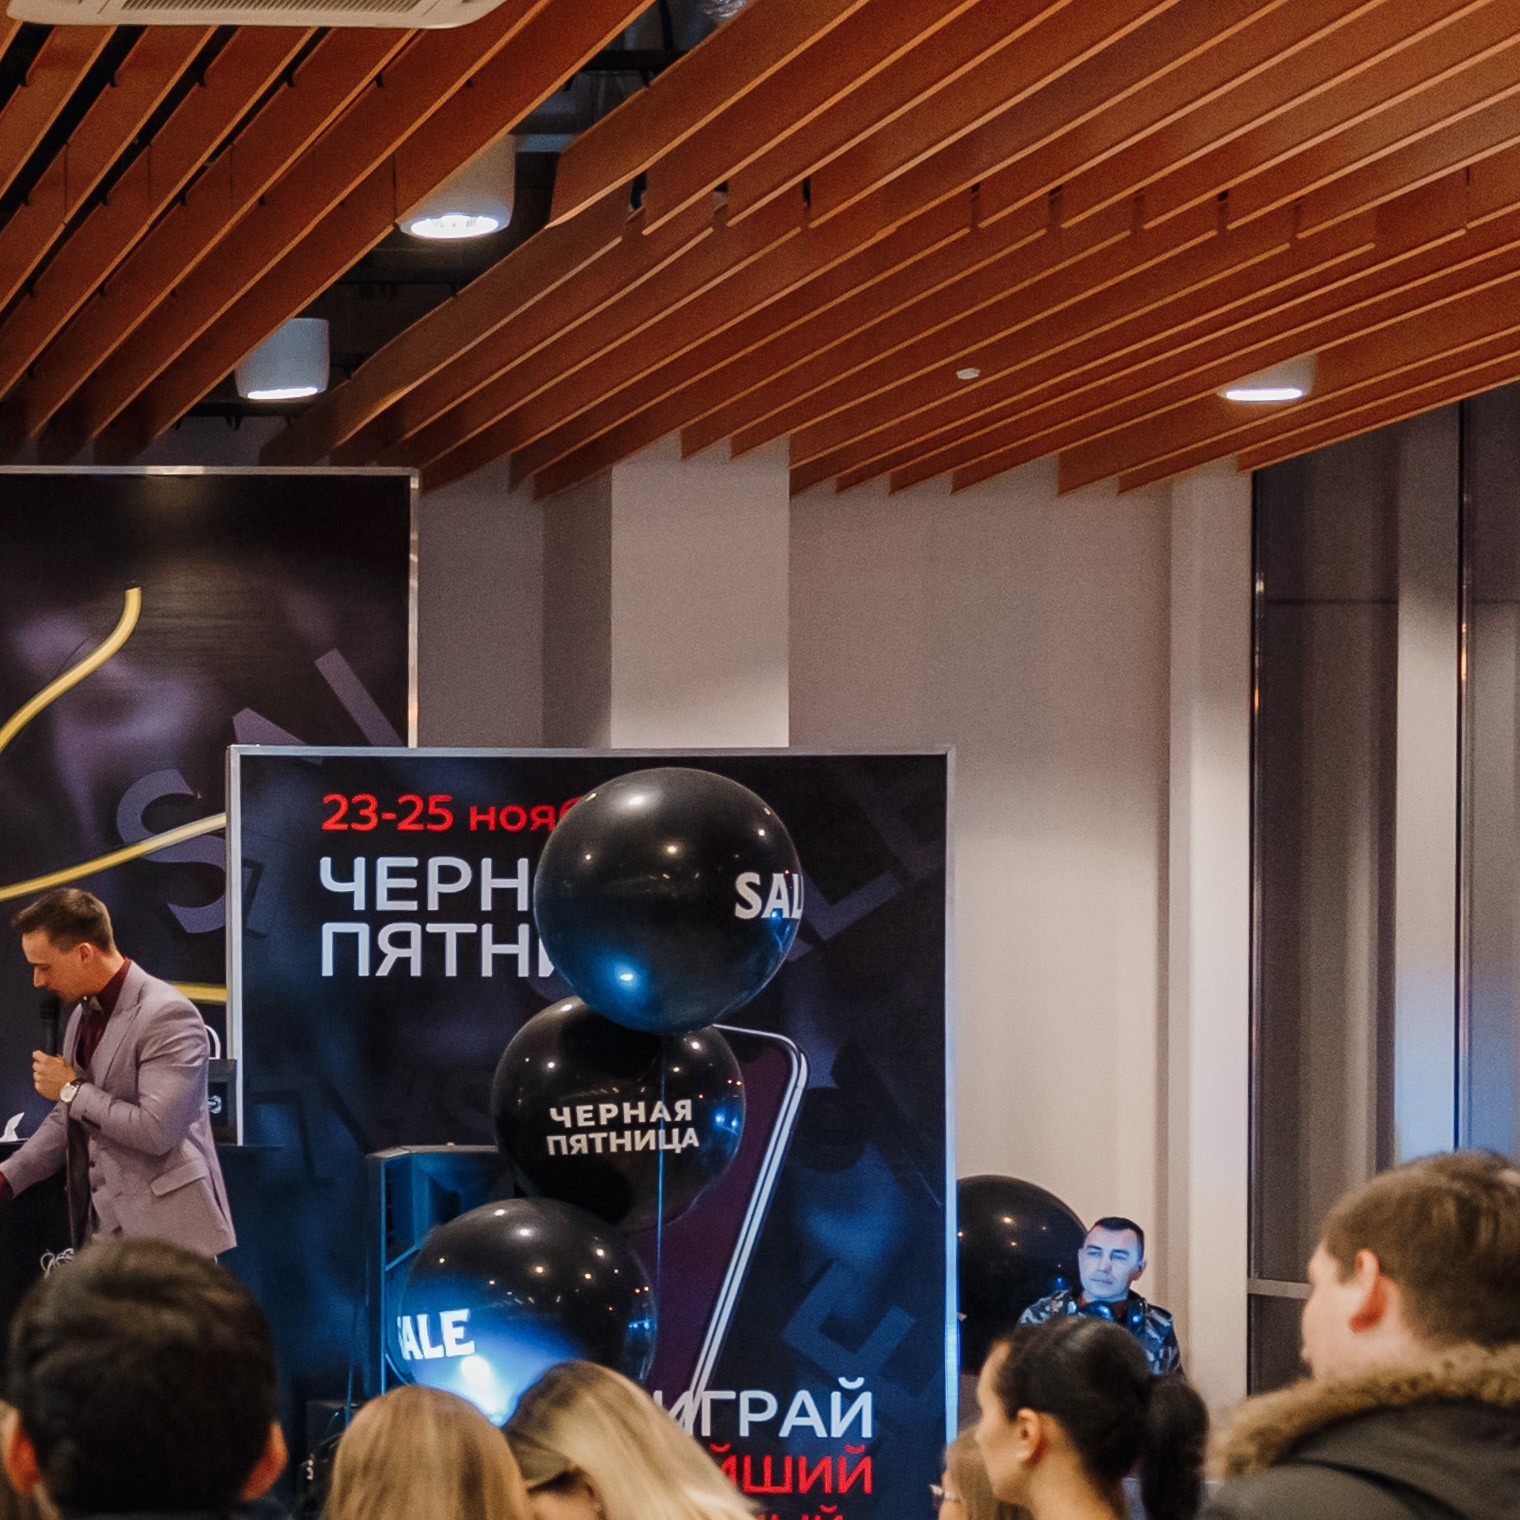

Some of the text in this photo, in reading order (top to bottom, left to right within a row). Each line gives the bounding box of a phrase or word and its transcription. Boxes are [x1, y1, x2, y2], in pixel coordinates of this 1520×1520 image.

[321, 793, 582, 831] 23-25 ноя
[319, 856, 529, 912] ЧЕРН
[734, 872, 802, 920] SAL
[321, 922, 555, 978] ПЯТН
[549, 1099, 693, 1128] ЧЕРНАЯ
[546, 1127, 700, 1156] ПЯТНИЦА
[397, 1308, 475, 1361] ALE
[653, 1376, 872, 1439] ИГРАЙ
